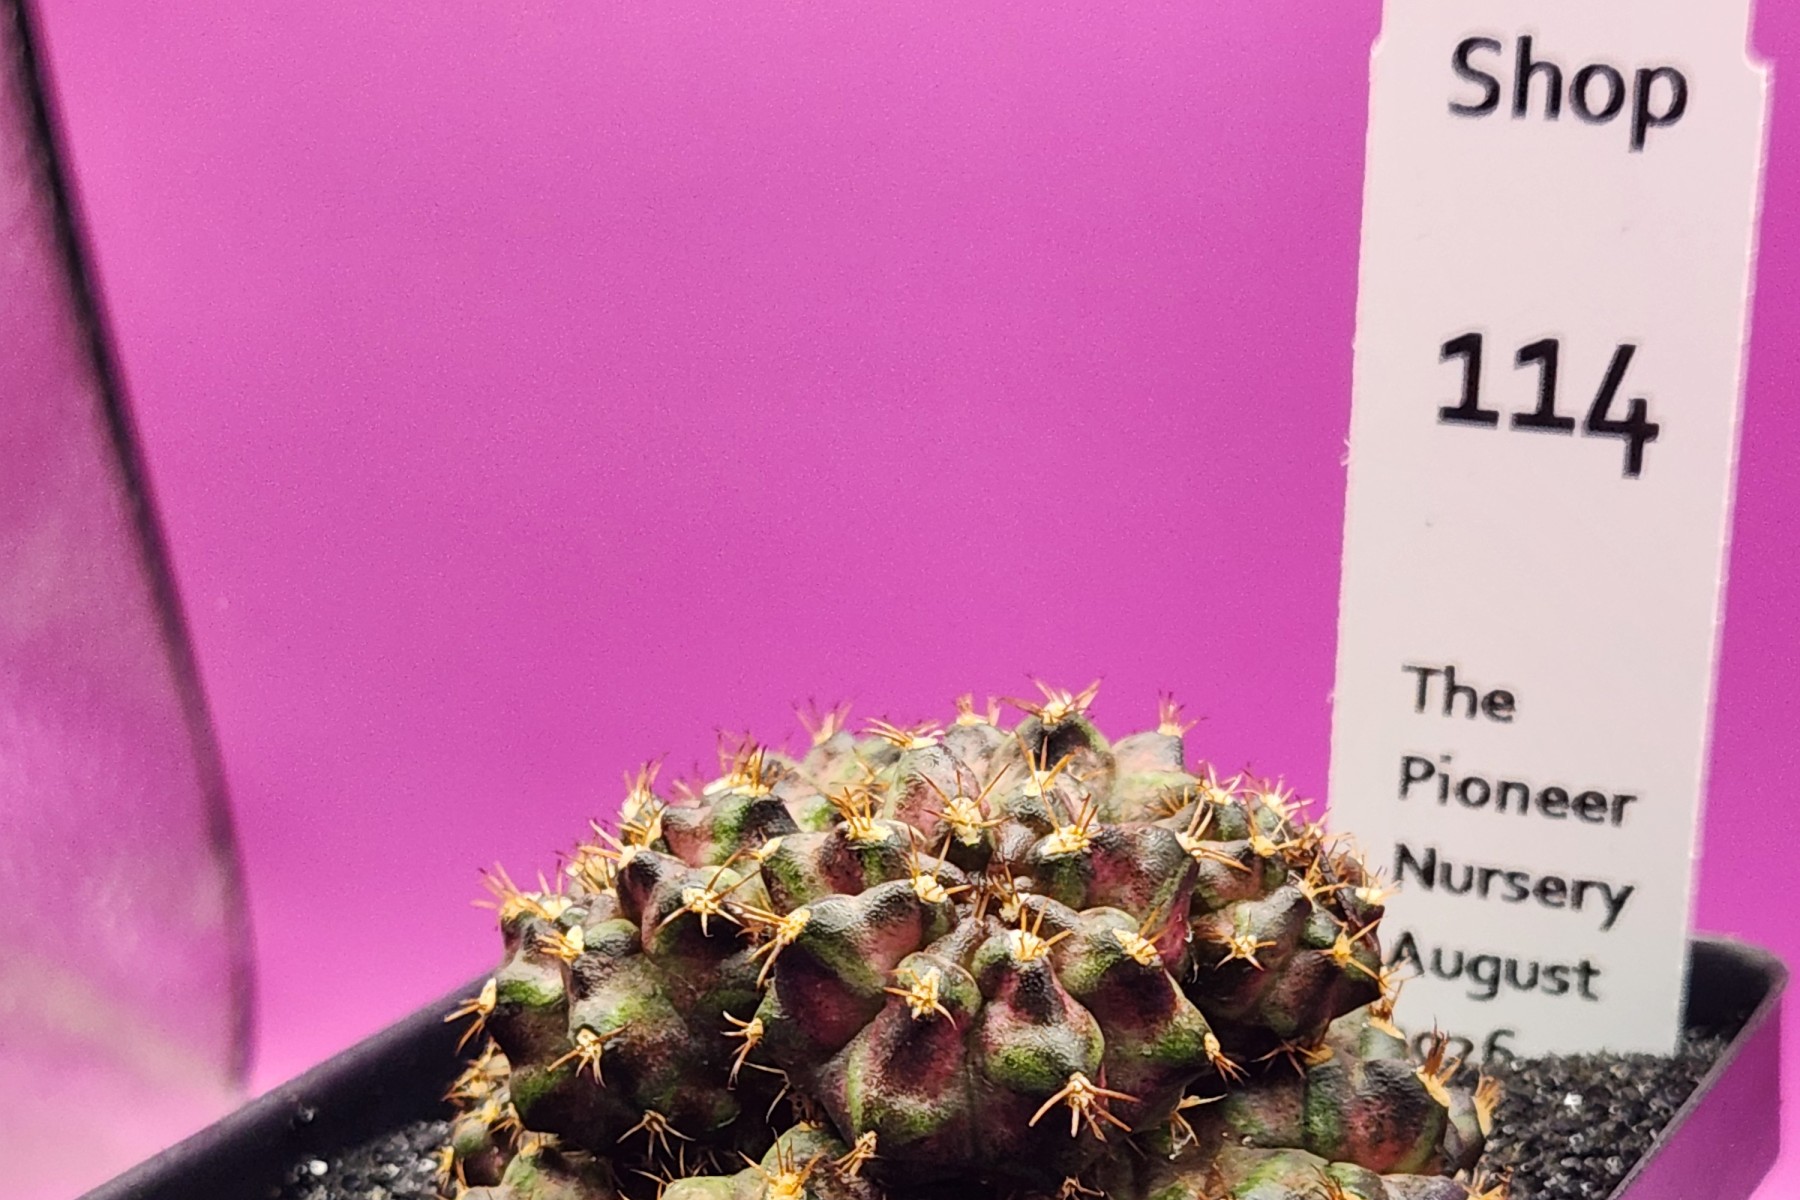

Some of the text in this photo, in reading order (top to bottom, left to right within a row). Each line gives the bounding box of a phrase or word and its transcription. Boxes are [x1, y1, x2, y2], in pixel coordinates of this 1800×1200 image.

[1448, 35, 1688, 153] Shop
[1437, 332, 1661, 480] 114
[1401, 665, 1517, 723] The
[1398, 755, 1638, 827] Pioneer
[1392, 843, 1635, 933] Nursery
[1386, 931, 1601, 1001] August
